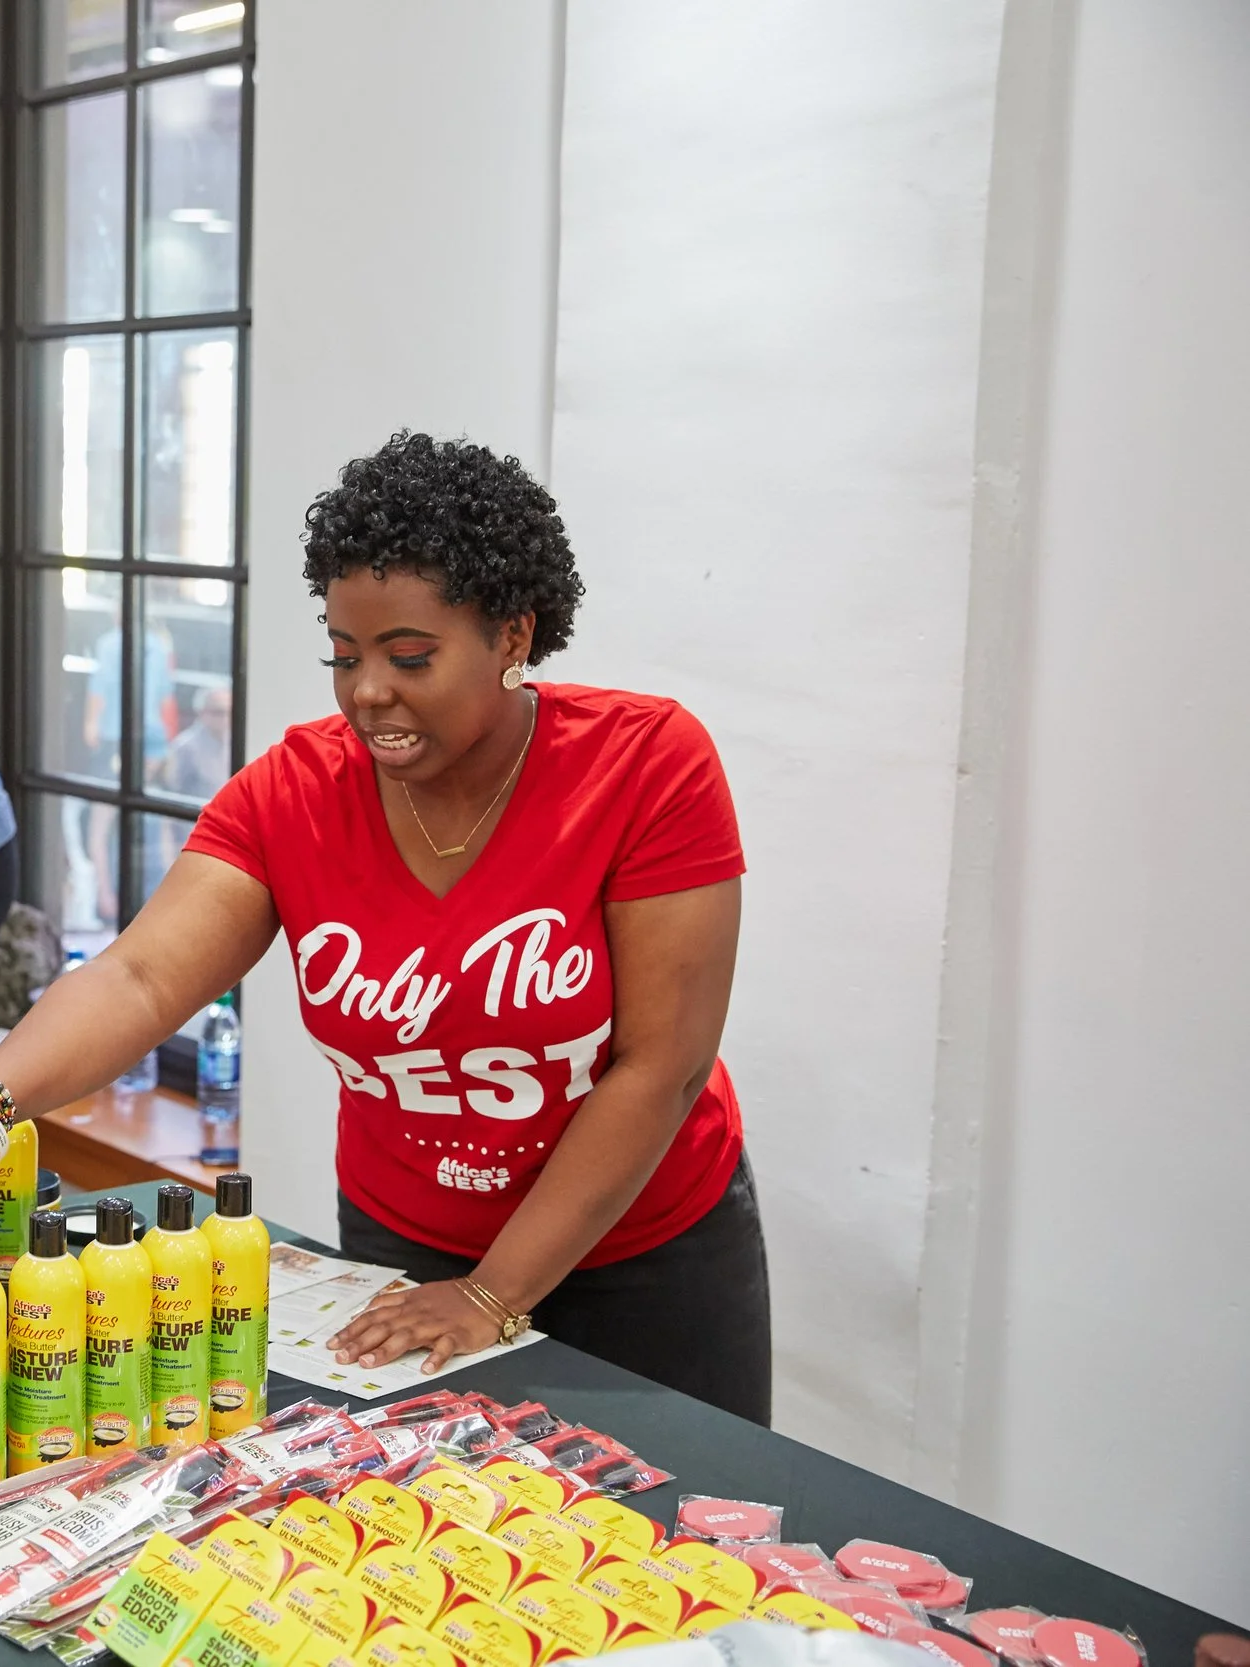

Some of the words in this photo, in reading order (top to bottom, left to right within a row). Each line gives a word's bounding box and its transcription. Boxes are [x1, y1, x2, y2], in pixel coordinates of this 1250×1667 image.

[297, 921, 452, 1044] Only
[460, 907, 594, 1017] The
[311, 1018, 611, 1121] BEST
[436, 1156, 510, 1181] Africa's
[436, 1173, 510, 1193] BEST
[152, 1274, 179, 1284] rica's
[152, 1281, 178, 1291] EST
[13, 1308, 51, 1320] BEST
[14, 1299, 51, 1313] Africa's
[86, 1297, 105, 1306] ST
[152, 1295, 192, 1311] tures
[7, 1314, 65, 1340] Textures
[86, 1314, 119, 1328] ures
[152, 1320, 204, 1337] TURE
[157, 1312, 184, 1322] Butter
[8, 1342, 78, 1367] OISTURE
[30, 1341, 57, 1351] Butter
[86, 1336, 134, 1353] TURE
[151, 1336, 190, 1351] NEW
[9, 1358, 63, 1381] ENEW
[238, 1444, 268, 1464] BEST
[101, 1493, 127, 1509] BES
[62, 1519, 100, 1549] COMB
[69, 1509, 109, 1538] BRUSH
[345, 1509, 370, 1527] ULTRA
[372, 1523, 406, 1546] SMOOTH
[279, 1530, 303, 1549] ULTRA
[305, 1544, 339, 1568] SMOOTH
[138, 1553, 199, 1600] Textures
[207, 1551, 231, 1571] ULTRA
[232, 1567, 264, 1592] SMOOTH
[130, 1584, 178, 1622] SMOOTH
[143, 1577, 179, 1607] ULTRA
[361, 1575, 387, 1594] ULTRA
[388, 1589, 425, 1616] SMOOTH
[121, 1595, 168, 1635] EDGES
[286, 1601, 311, 1621] ULTRA
[313, 1618, 348, 1645] SMOOTH
[206, 1636, 254, 1667] SMOOT
[221, 1629, 259, 1662] ULTRA
